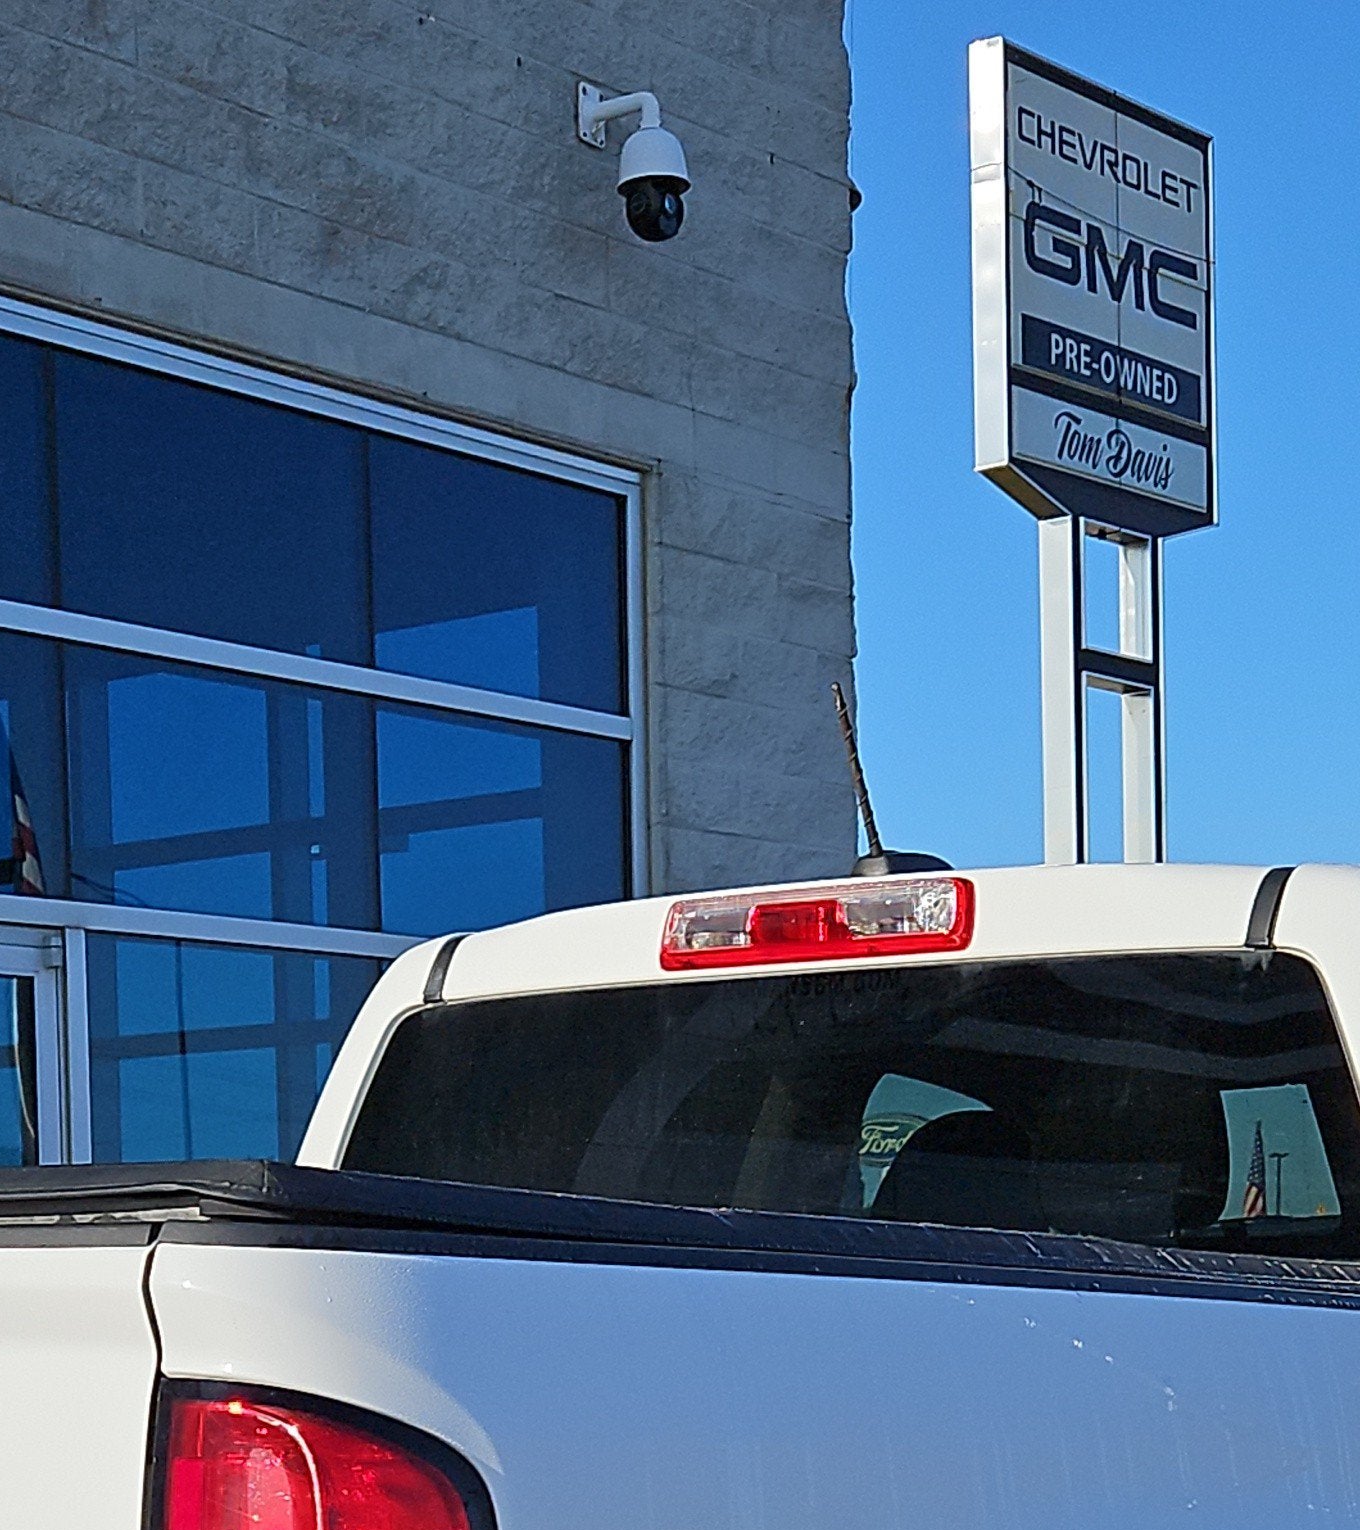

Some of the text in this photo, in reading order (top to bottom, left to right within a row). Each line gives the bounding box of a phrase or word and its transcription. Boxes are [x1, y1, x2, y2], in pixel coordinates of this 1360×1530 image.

[1017, 105, 1199, 214] CHEVROLET
[1024, 200, 1198, 331] GMC
[1050, 332, 1178, 405] PRE-OWNED
[1054, 410, 1175, 491] Tom Davis
